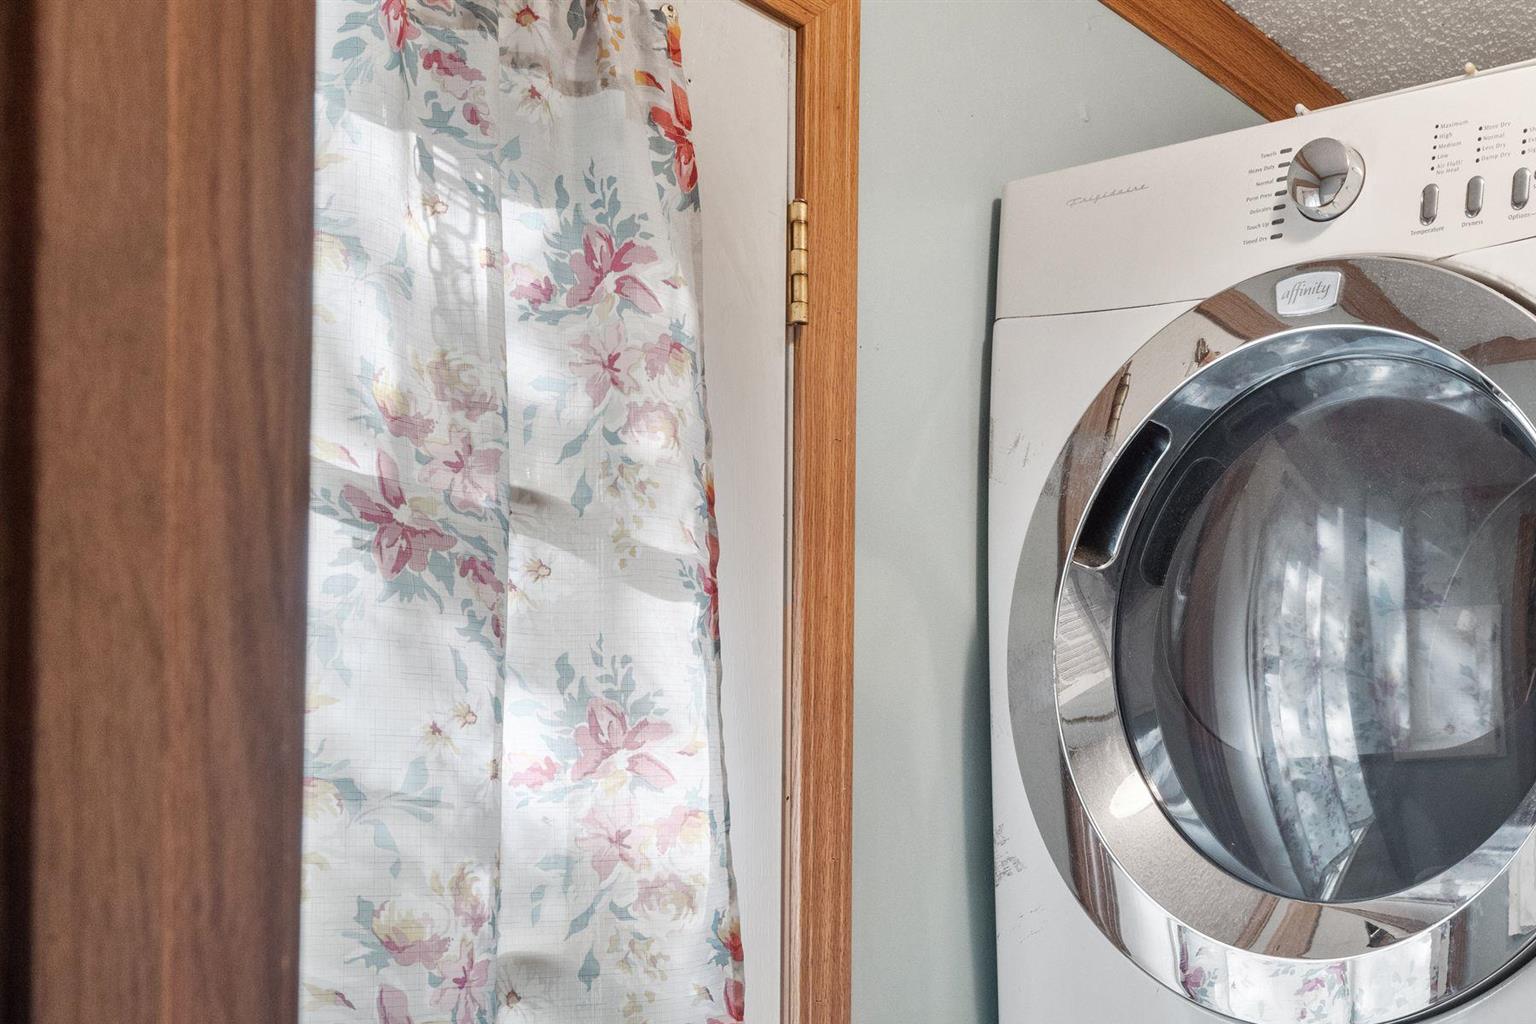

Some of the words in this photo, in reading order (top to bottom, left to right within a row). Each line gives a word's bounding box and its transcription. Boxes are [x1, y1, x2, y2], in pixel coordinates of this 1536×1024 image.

[1508, 212, 1530, 221] Options
[1461, 219, 1483, 228] Dryness
[1411, 226, 1444, 236] Temperature
[1281, 282, 1331, 305] affinity
